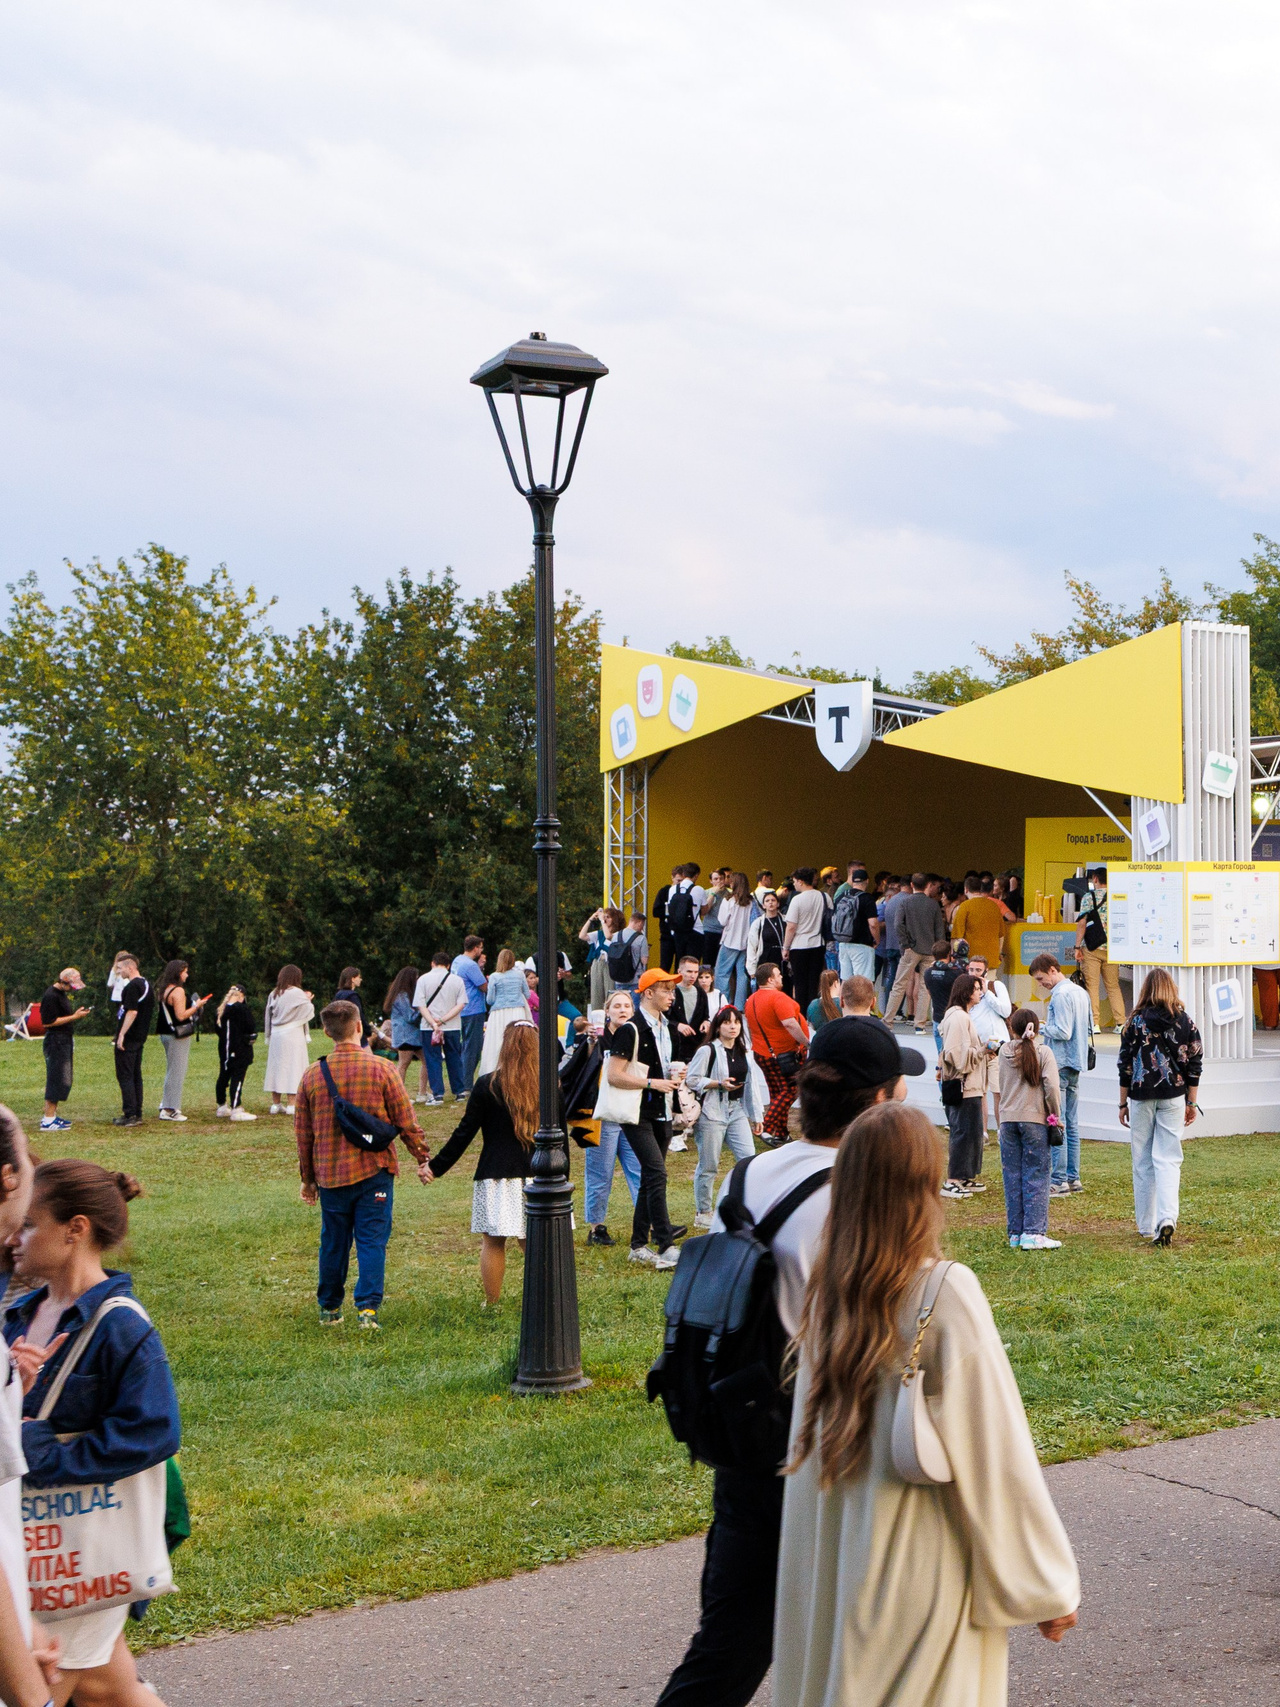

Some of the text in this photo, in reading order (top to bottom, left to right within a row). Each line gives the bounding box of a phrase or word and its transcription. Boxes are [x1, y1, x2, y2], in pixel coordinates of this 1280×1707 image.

[1066, 833, 1126, 845] Город в Т-Банке
[1128, 863, 1163, 871] Карта Города
[1213, 863, 1256, 871] Карта Города
[24, 1524, 63, 1552] SED
